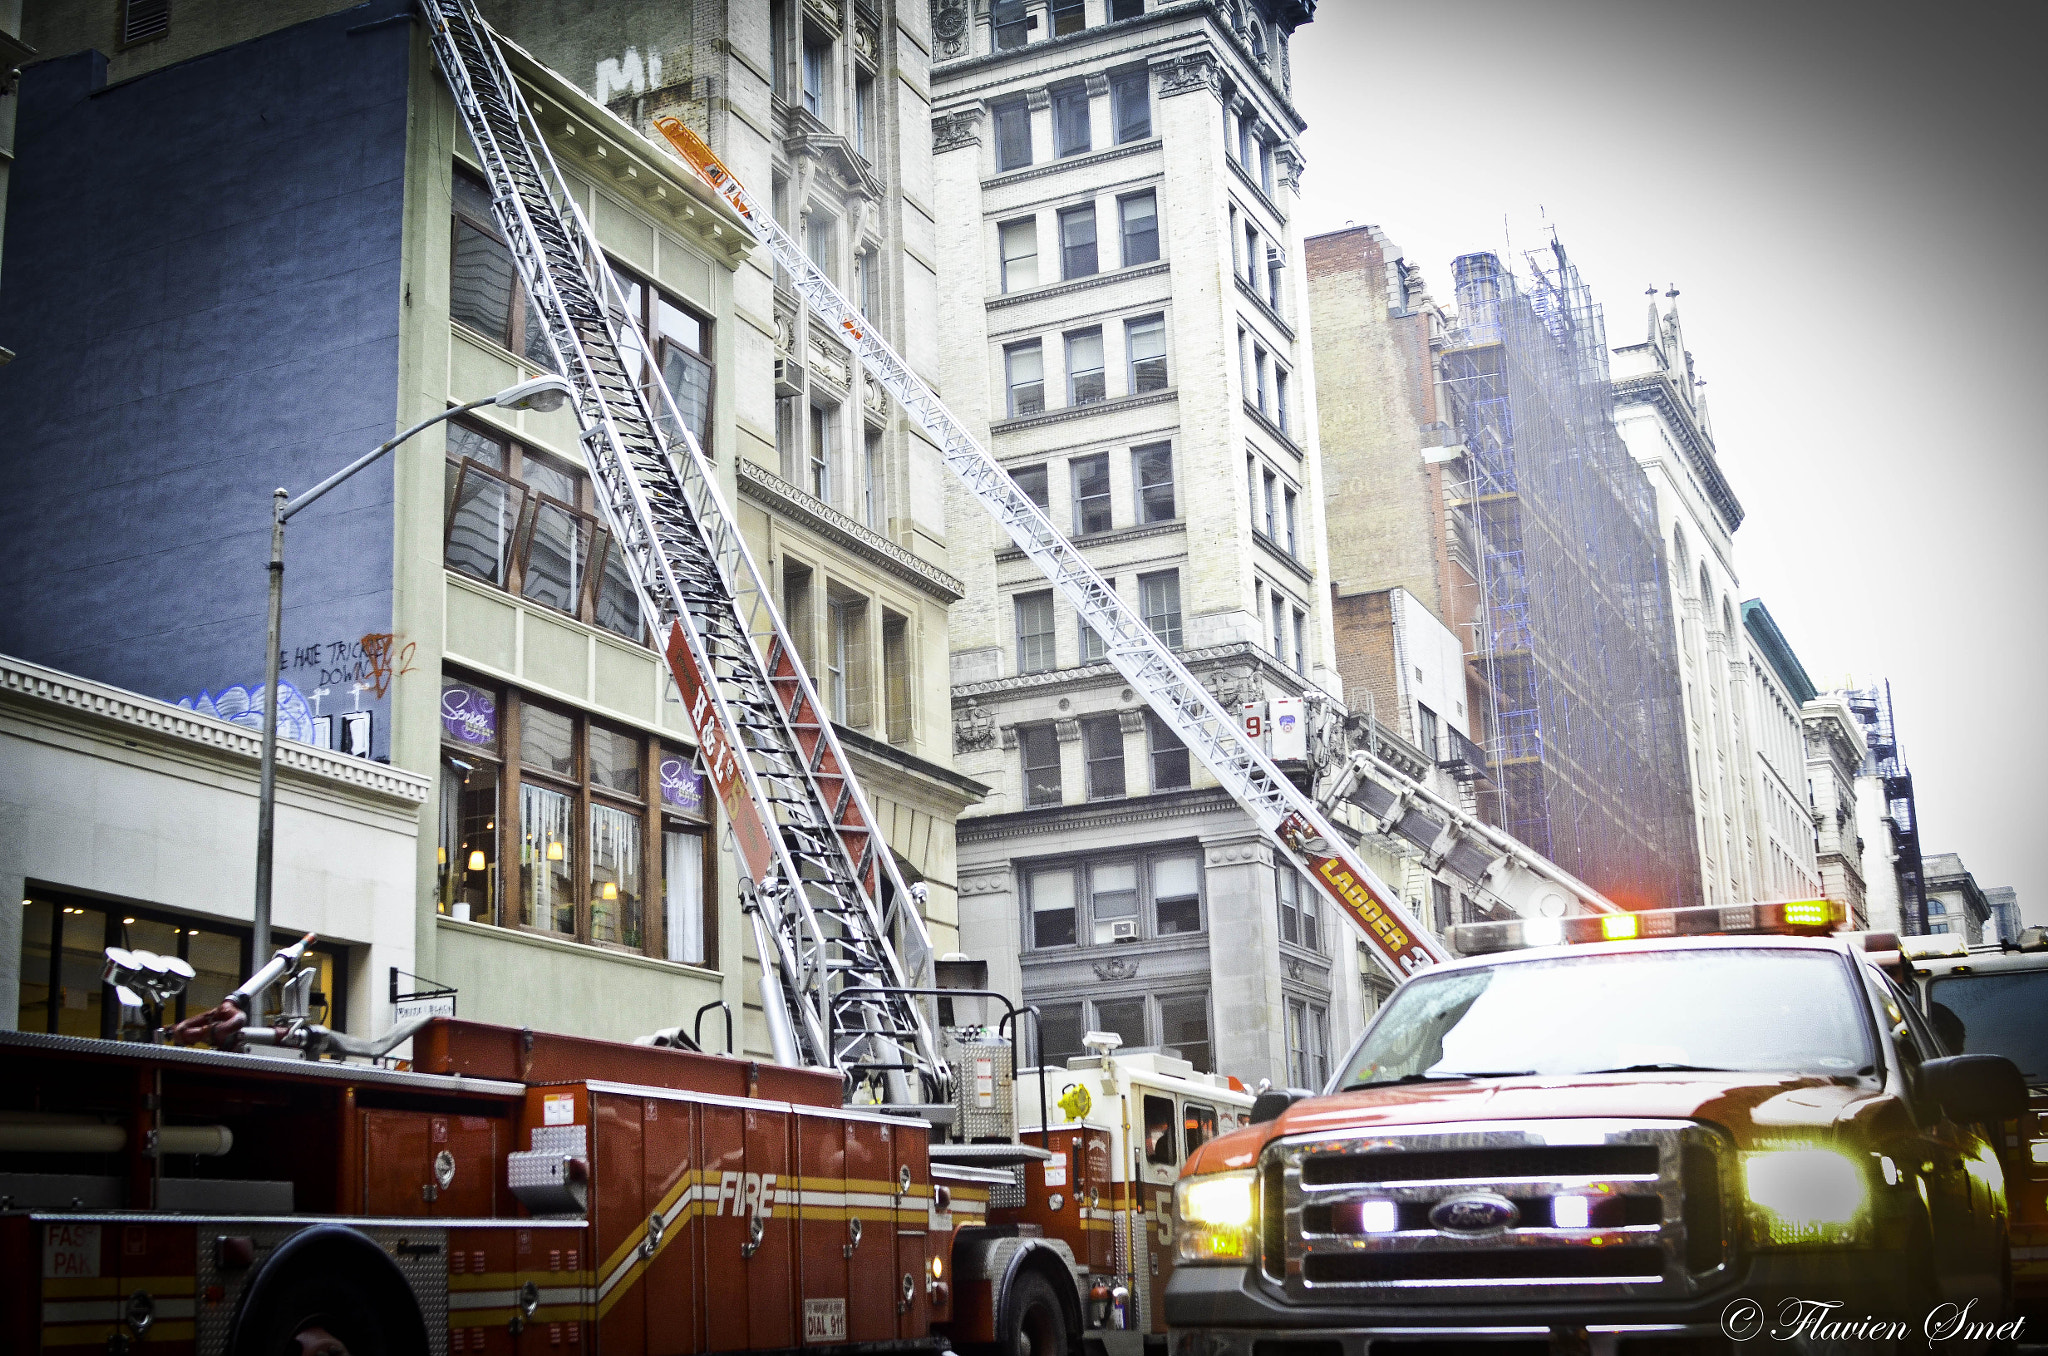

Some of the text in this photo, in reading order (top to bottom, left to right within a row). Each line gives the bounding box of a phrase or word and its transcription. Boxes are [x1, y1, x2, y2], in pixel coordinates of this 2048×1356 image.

[294, 643, 321, 668] HATE
[320, 661, 369, 686] DOWN
[1246, 716, 1260, 738] 9
[1319, 858, 1409, 952] LADDER
[717, 1171, 777, 1218] FIRE
[1156, 1190, 1172, 1246] 5
[1449, 1202, 1496, 1225] Ford
[54, 1252, 92, 1275] PAK
[808, 1315, 843, 1335] DIAL 911
